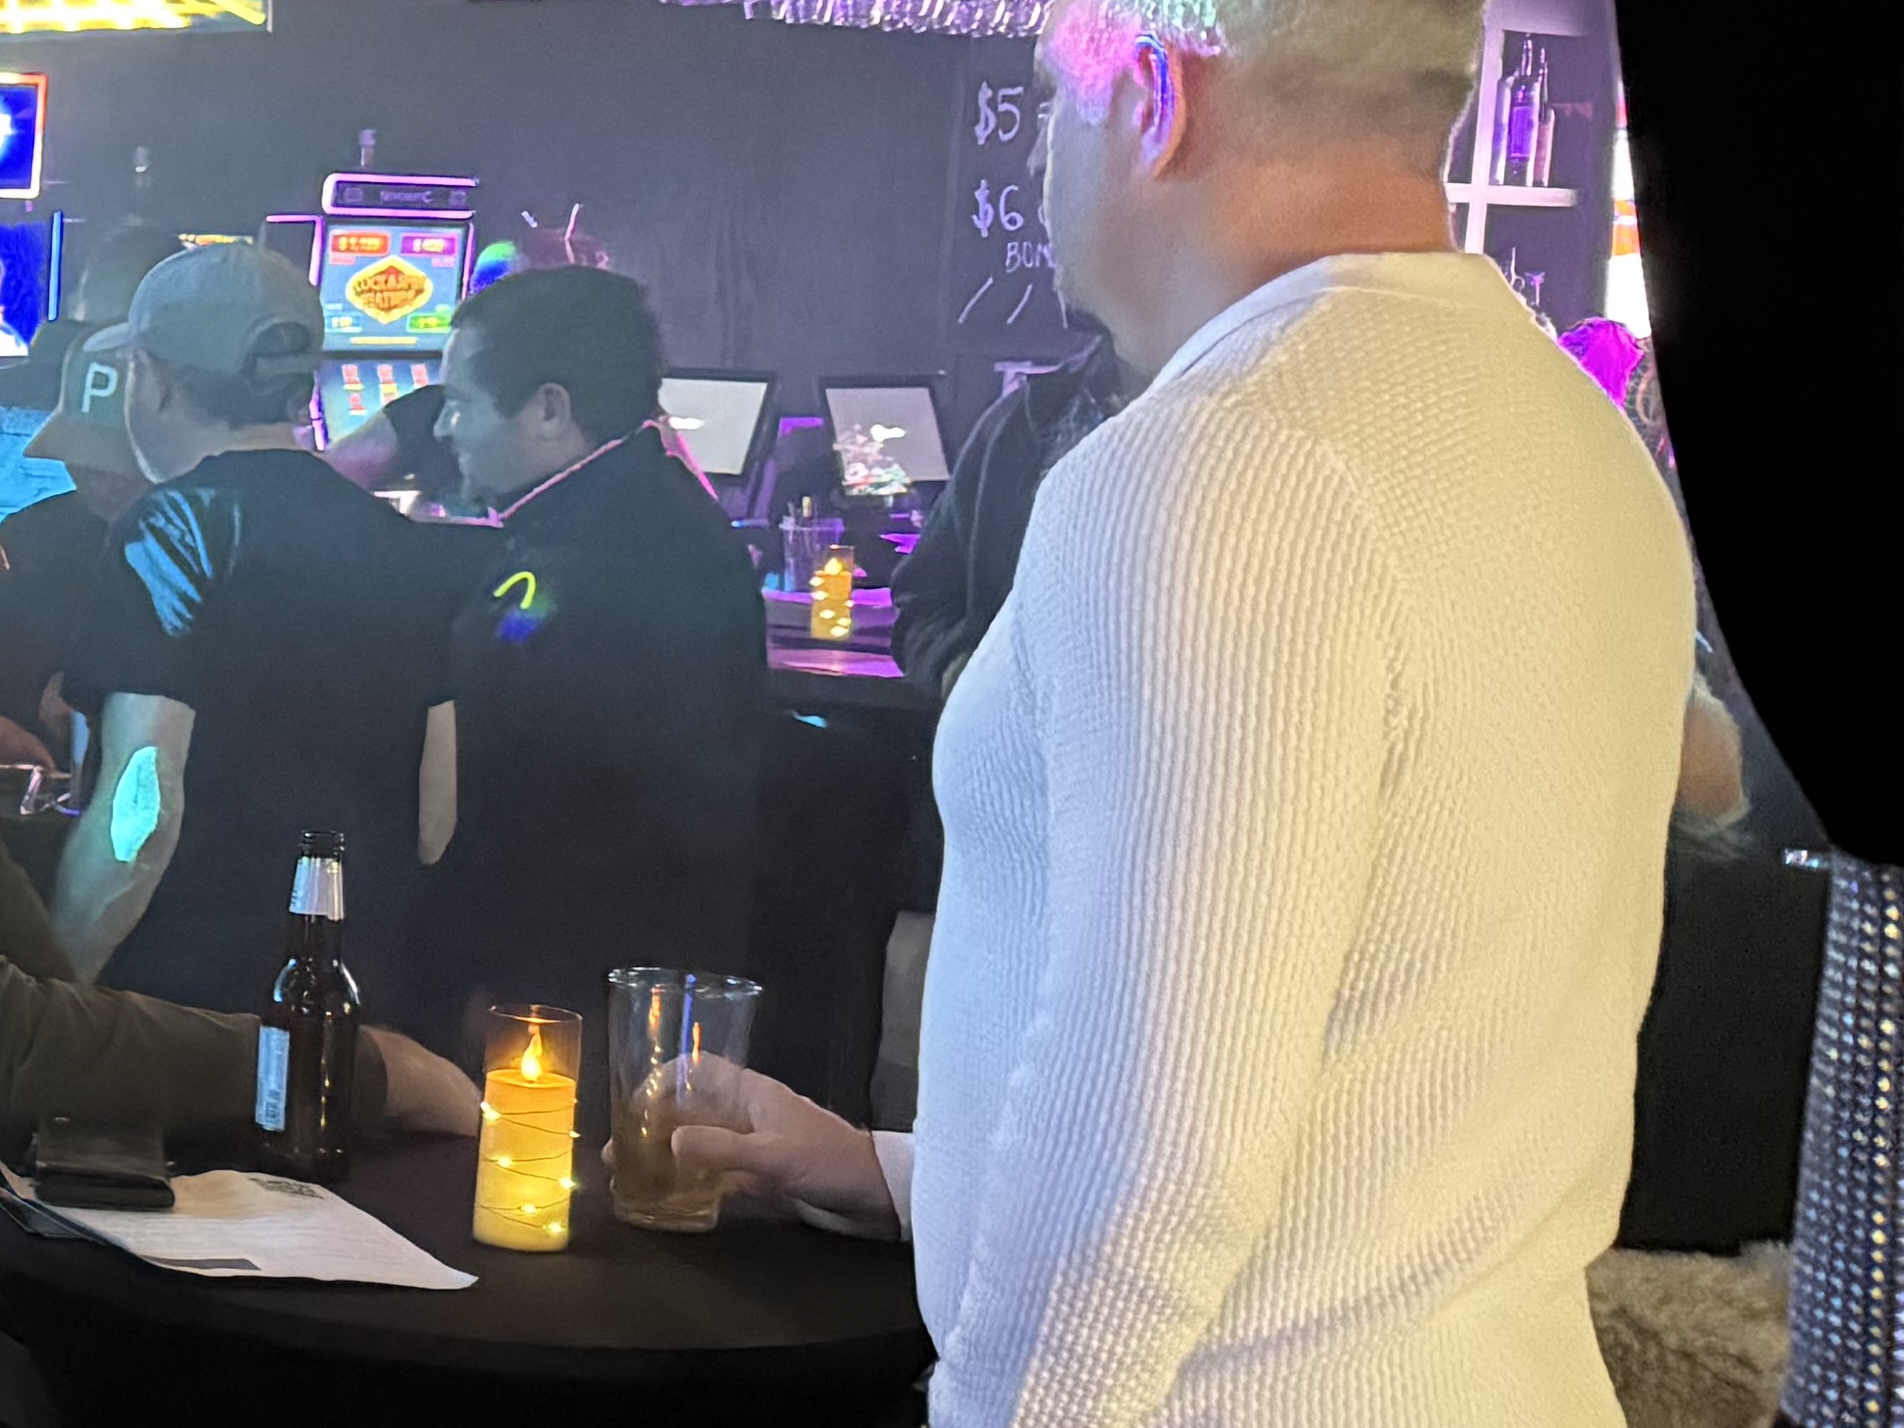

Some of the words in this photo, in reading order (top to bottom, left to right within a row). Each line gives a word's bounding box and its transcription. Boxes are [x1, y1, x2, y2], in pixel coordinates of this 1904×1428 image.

[974, 80, 1024, 145] $5
[970, 179, 1024, 238] $6
[80, 361, 119, 413] P
